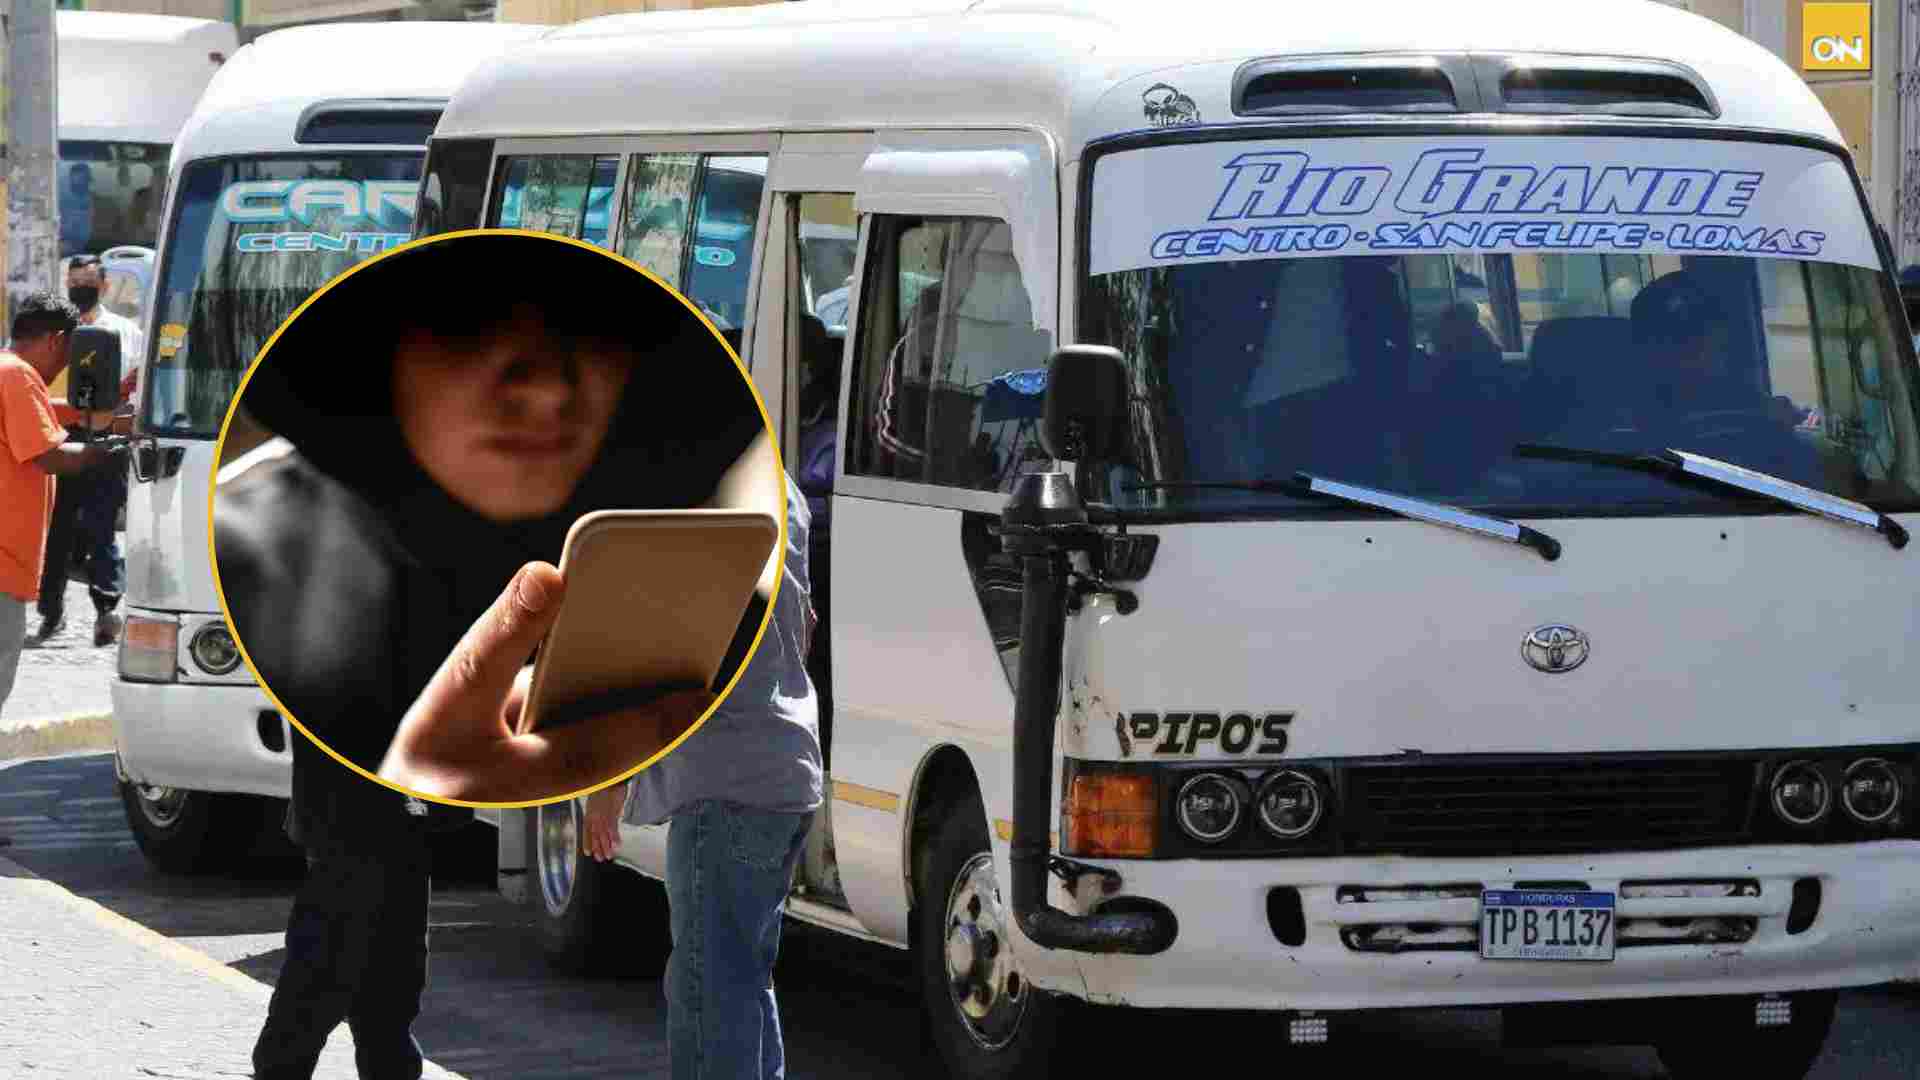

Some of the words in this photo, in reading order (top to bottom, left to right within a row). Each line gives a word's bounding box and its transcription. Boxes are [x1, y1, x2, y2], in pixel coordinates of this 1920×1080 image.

[1207, 151, 1393, 221] RIO
[1394, 148, 1765, 218] GRANDE
[1151, 222, 1351, 260] CENTRO
[1666, 223, 1827, 256] LOMAS
[1118, 712, 1295, 756] PIPO'S
